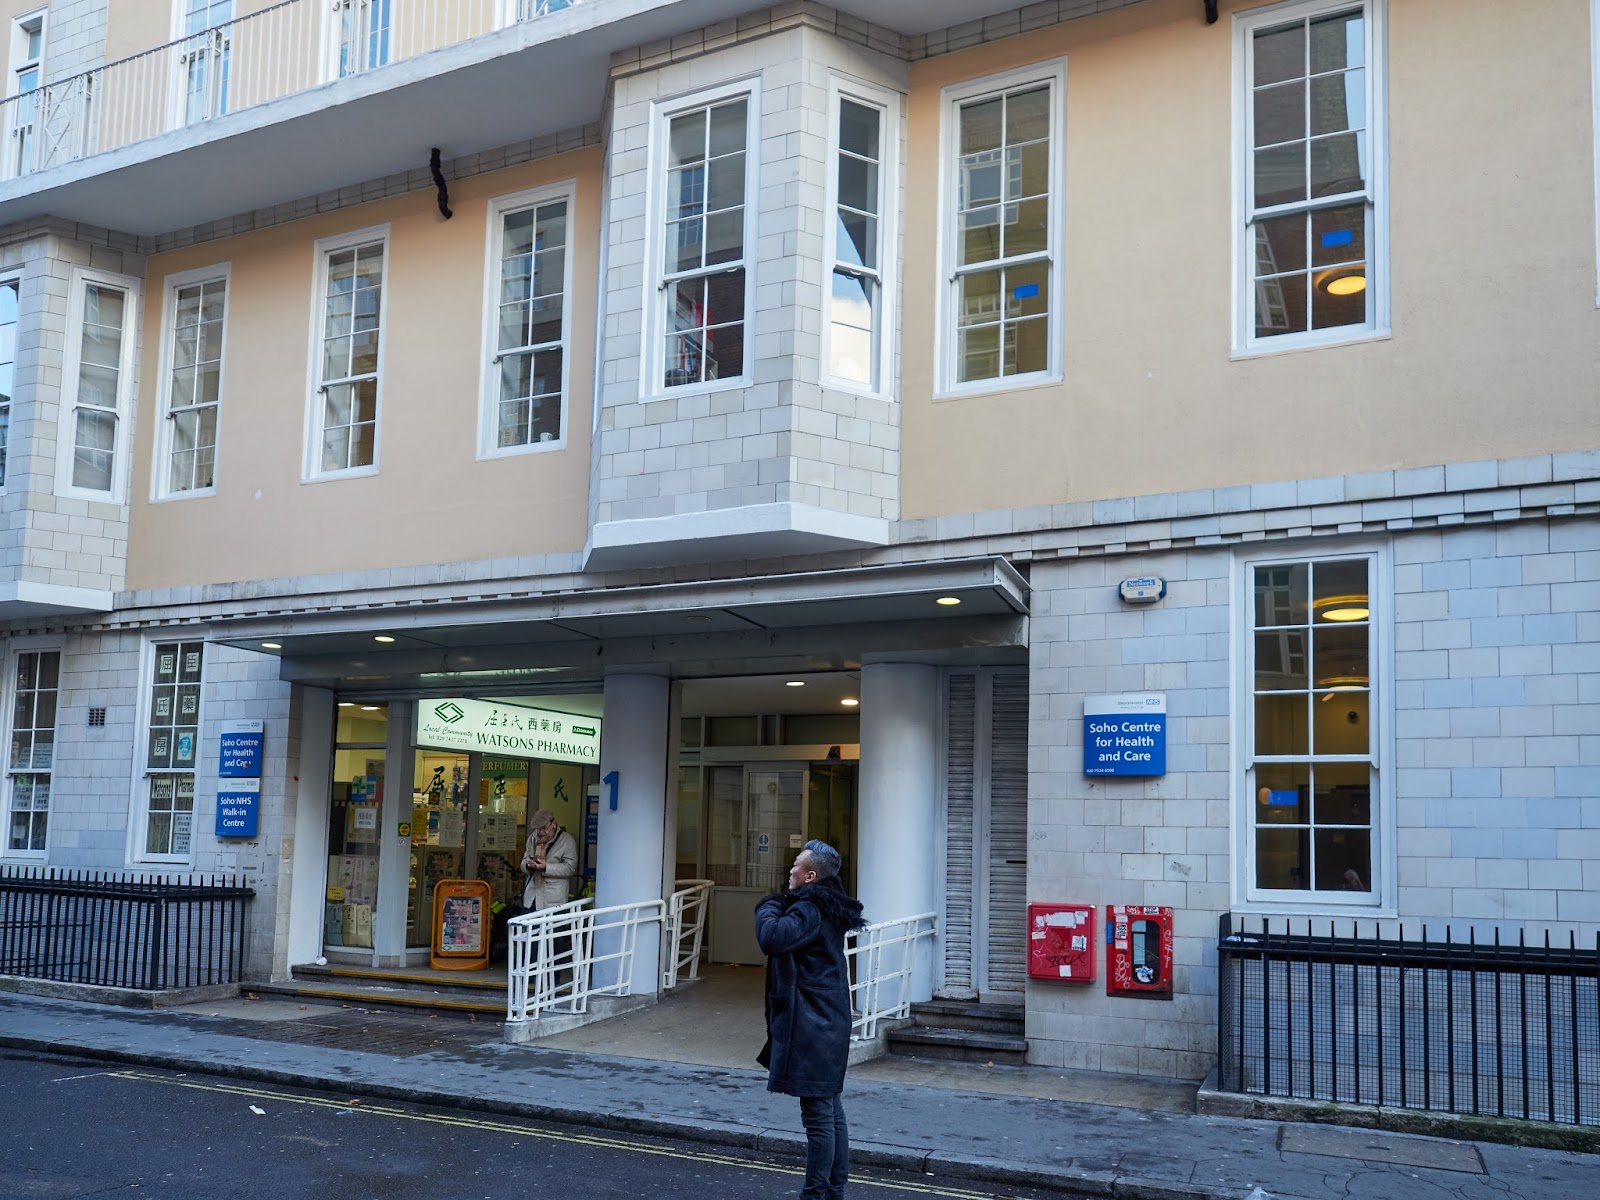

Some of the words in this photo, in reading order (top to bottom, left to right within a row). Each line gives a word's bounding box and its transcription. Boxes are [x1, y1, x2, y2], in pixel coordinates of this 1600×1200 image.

[1090, 722, 1118, 733] Soho
[1122, 722, 1161, 732] Centre
[236, 738, 258, 746] Centre
[476, 732, 534, 750] WATSONS
[537, 740, 597, 758] PHARMACY
[1096, 737, 1112, 747] for
[1116, 736, 1154, 746] Health
[232, 748, 254, 756] Health
[1098, 751, 1120, 762] and
[1124, 751, 1151, 761] Care
[236, 759, 252, 767] Ca
[603, 770, 619, 811] 1
[222, 808, 246, 816] Walk-in
[223, 818, 244, 827] Centre
